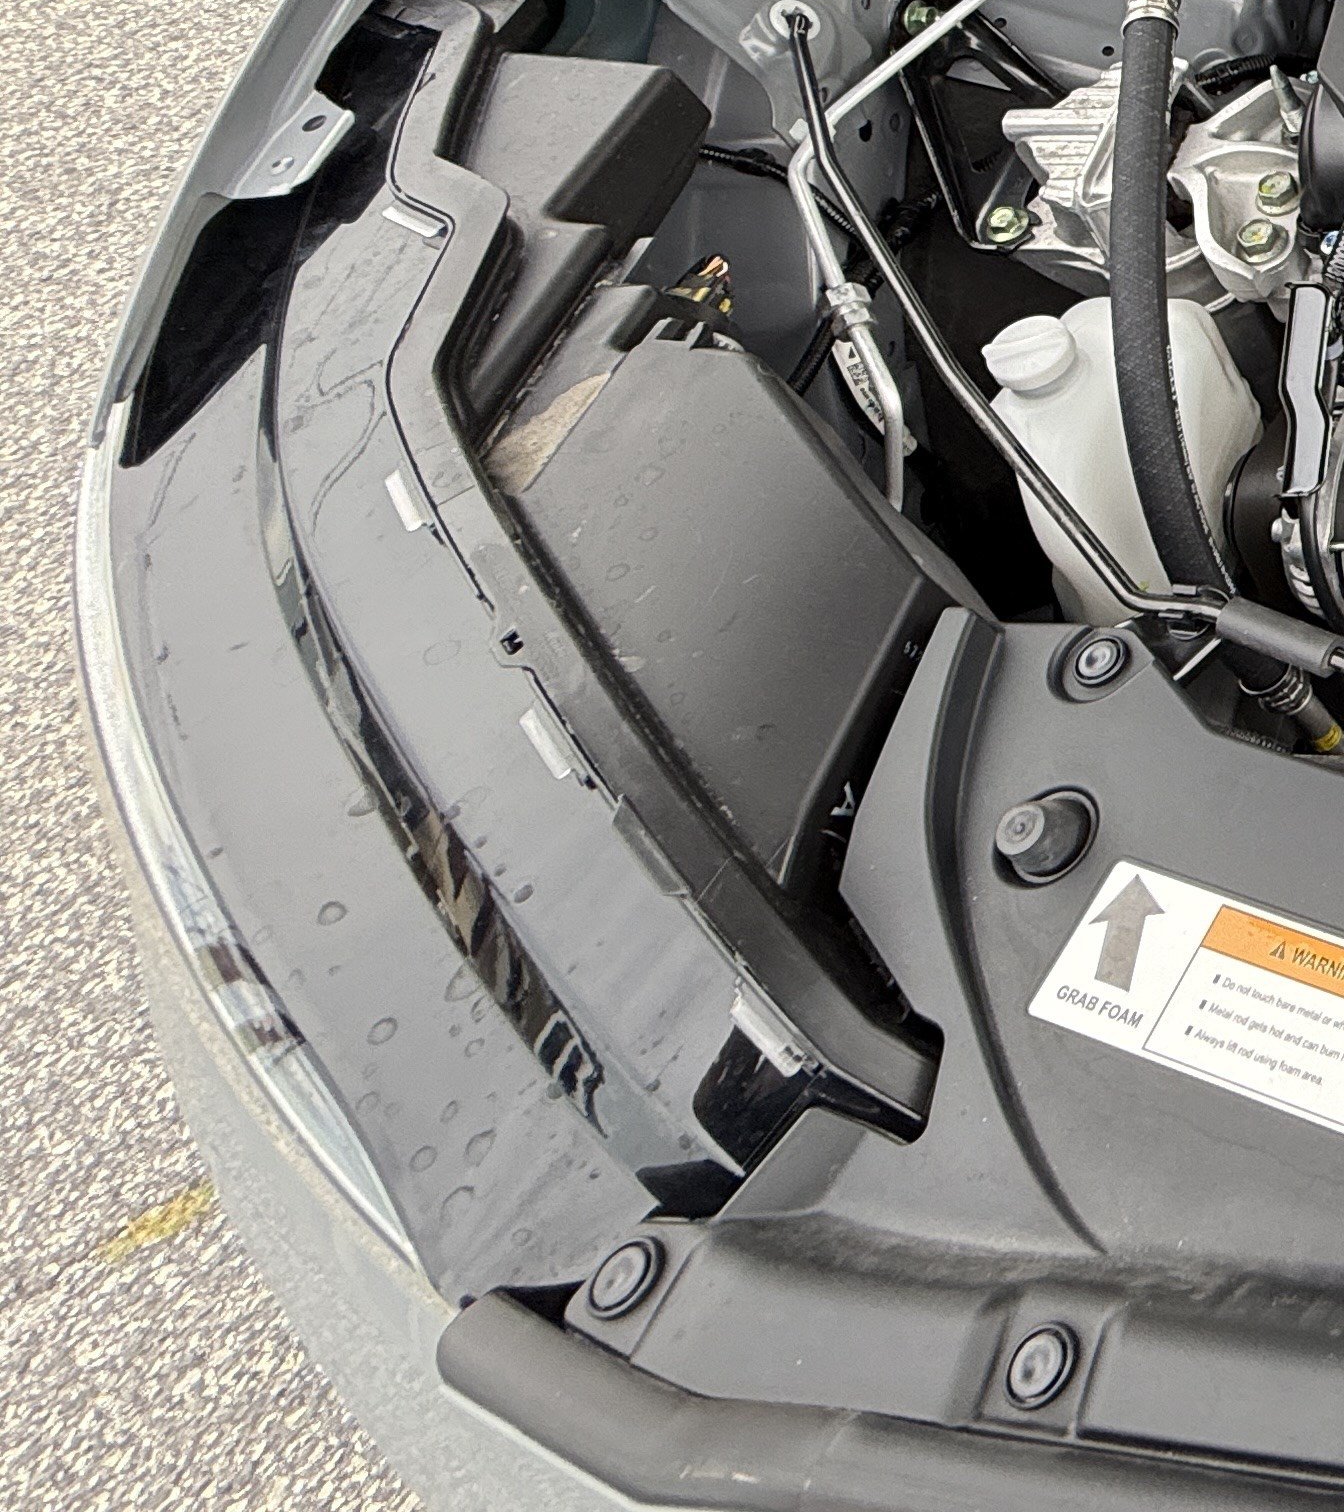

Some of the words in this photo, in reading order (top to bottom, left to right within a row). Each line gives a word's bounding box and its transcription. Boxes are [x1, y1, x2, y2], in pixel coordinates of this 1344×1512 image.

[1056, 984, 1100, 1012] GRAB
[1097, 999, 1145, 1029] FOAM
[1222, 977, 1236, 991] Do
[1236, 983, 1252, 997] not
[1251, 989, 1275, 1005] touch
[1276, 997, 1296, 1013] bare
[1297, 1006, 1323, 1022] metal
[1322, 1015, 1333, 1026] or
[1194, 1029, 1225, 1050] Always
[1225, 1039, 1239, 1054] lift
[1238, 1046, 1255, 1060] rod
[1253, 1051, 1278, 1071] using
[1278, 1059, 1302, 1078] foam
[1208, 1002, 1233, 1020] Metal
[1233, 1012, 1249, 1027] rod
[1248, 1018, 1268, 1034] gets
[1269, 1024, 1285, 1039] hot
[1284, 1032, 1303, 1046] and
[1303, 1039, 1319, 1053] can
[1320, 1043, 1341, 1060] burn
